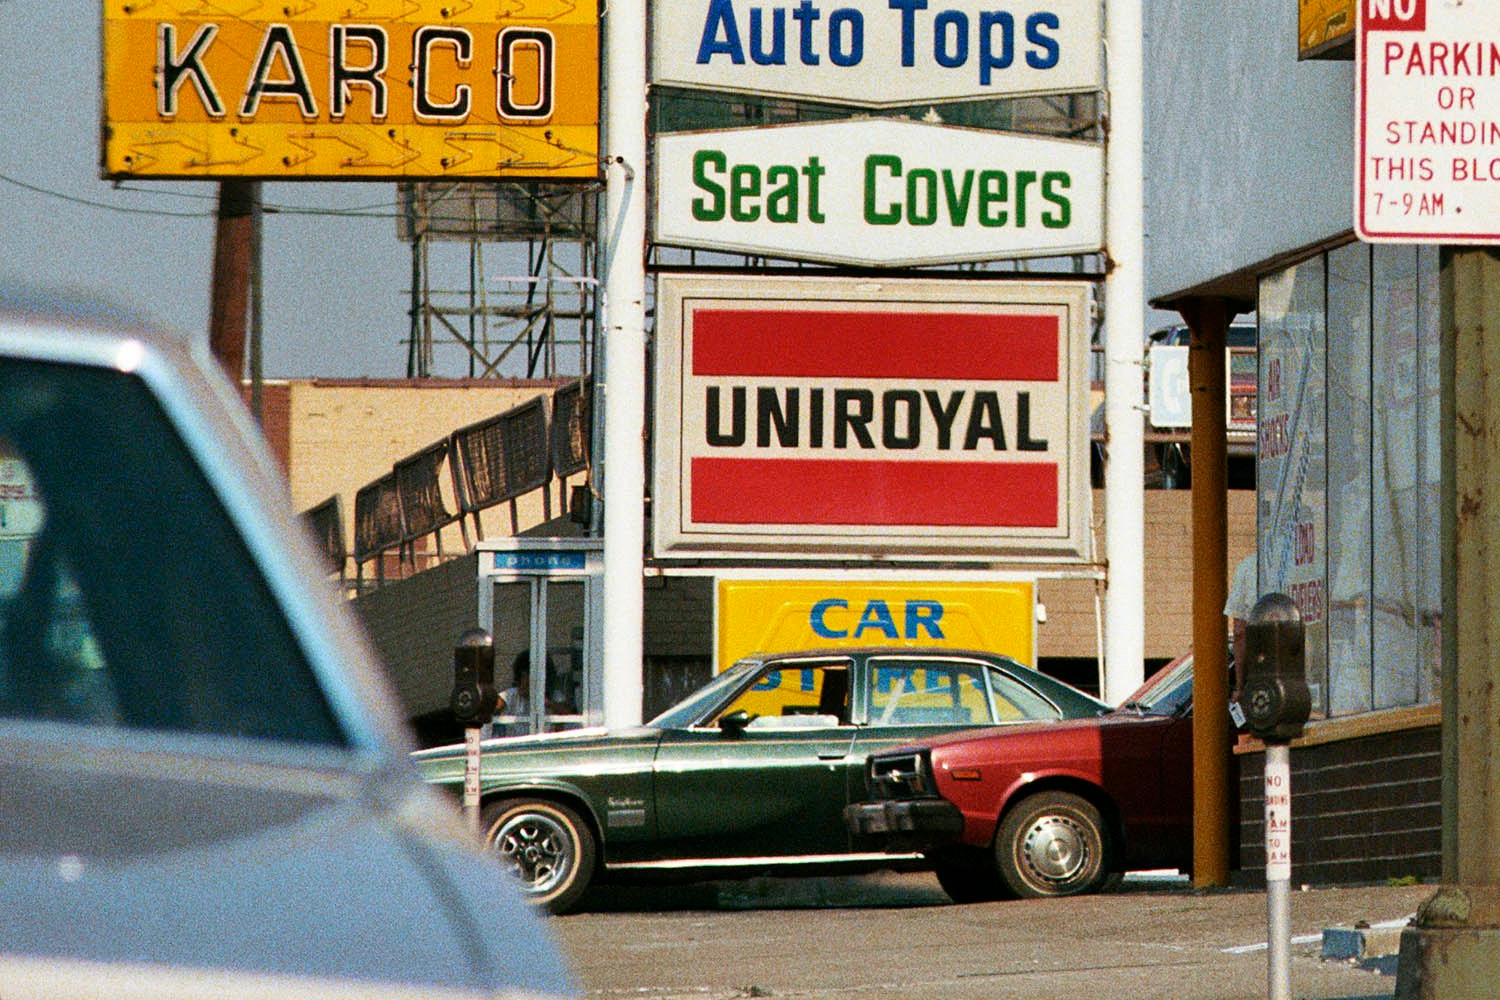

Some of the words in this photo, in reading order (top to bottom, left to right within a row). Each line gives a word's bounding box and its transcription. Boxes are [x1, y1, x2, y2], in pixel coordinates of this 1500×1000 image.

[155, 23, 556, 122] KARCO
[1437, 87, 1475, 110] OR
[1372, 157, 1434, 181] THIS
[692, 149, 826, 224] Seat
[863, 154, 1071, 229] Covers
[705, 385, 1049, 452] UNIROYAL
[506, 552, 572, 568] phone
[809, 598, 946, 639] CAR
[1267, 775, 1282, 788] NO
